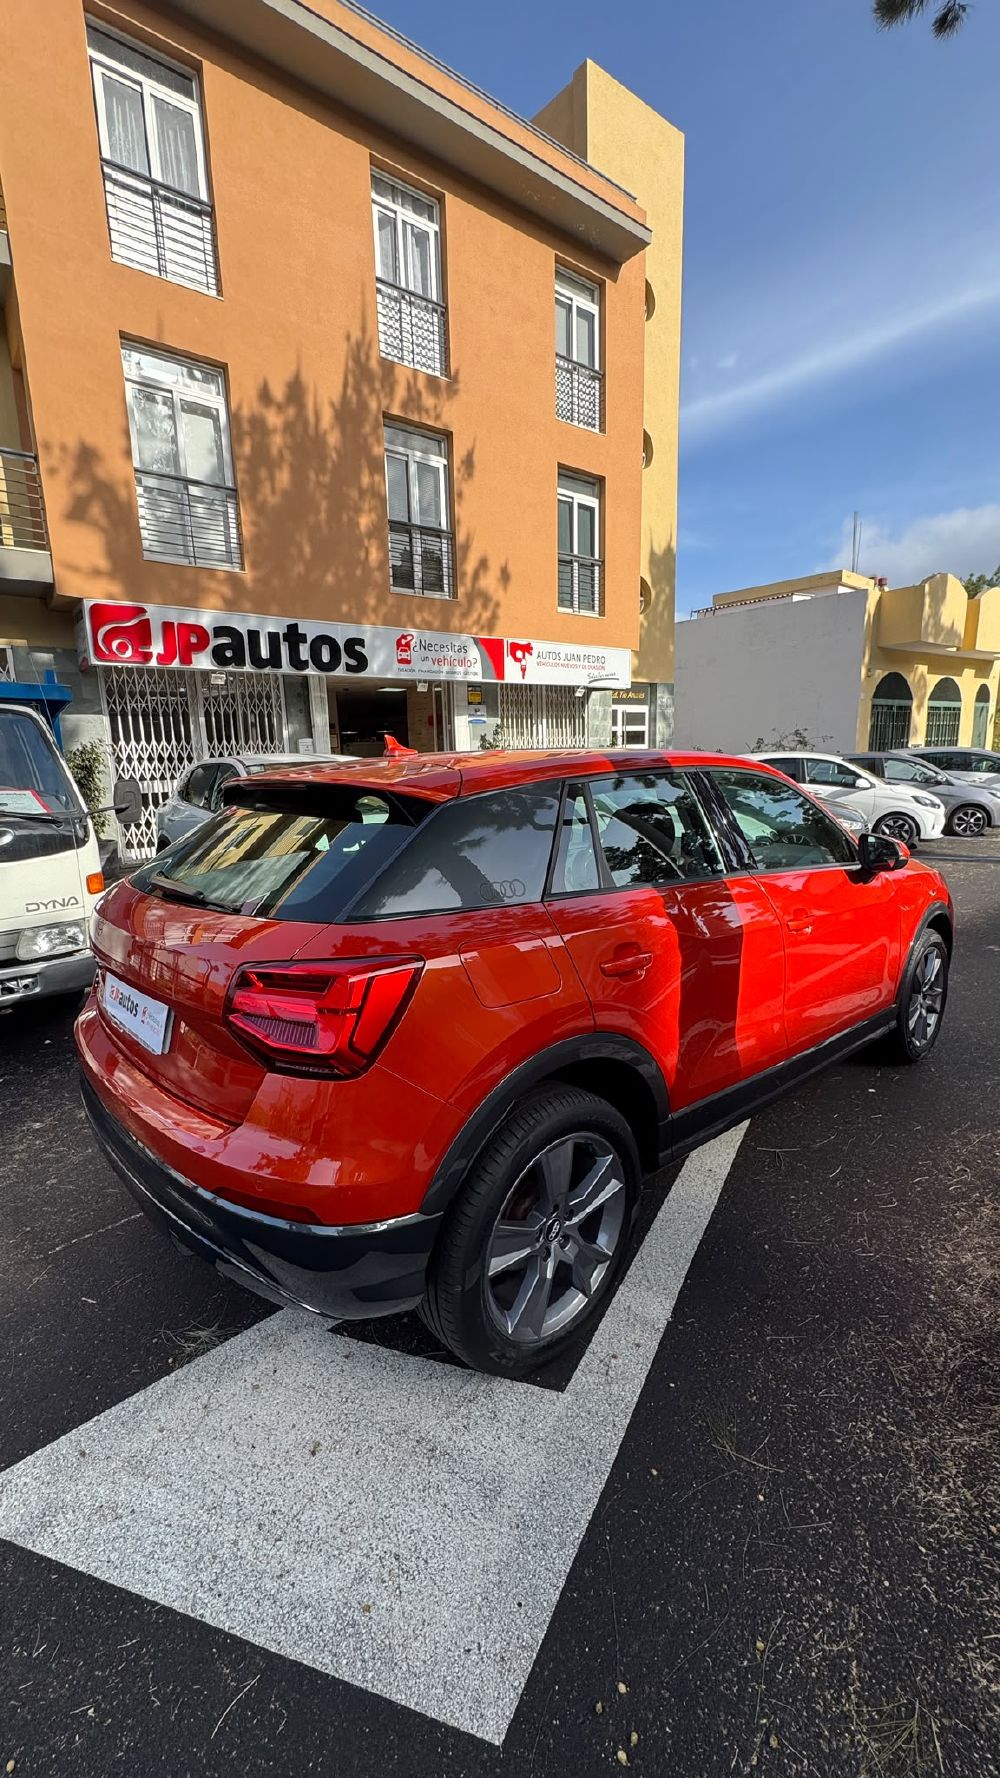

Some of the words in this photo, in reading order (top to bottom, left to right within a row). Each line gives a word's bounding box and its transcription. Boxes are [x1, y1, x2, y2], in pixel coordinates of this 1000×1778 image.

[156, 620, 368, 674] JPautos
[412, 639, 468, 654] ¿Necesitas
[420, 655, 430, 663] un
[431, 655, 478, 669] vehículo?
[536, 651, 562, 661] AUTOS
[563, 652, 581, 662] JUAN
[582, 653, 606, 665] PEDRO
[25, 896, 79, 913] DYNA
